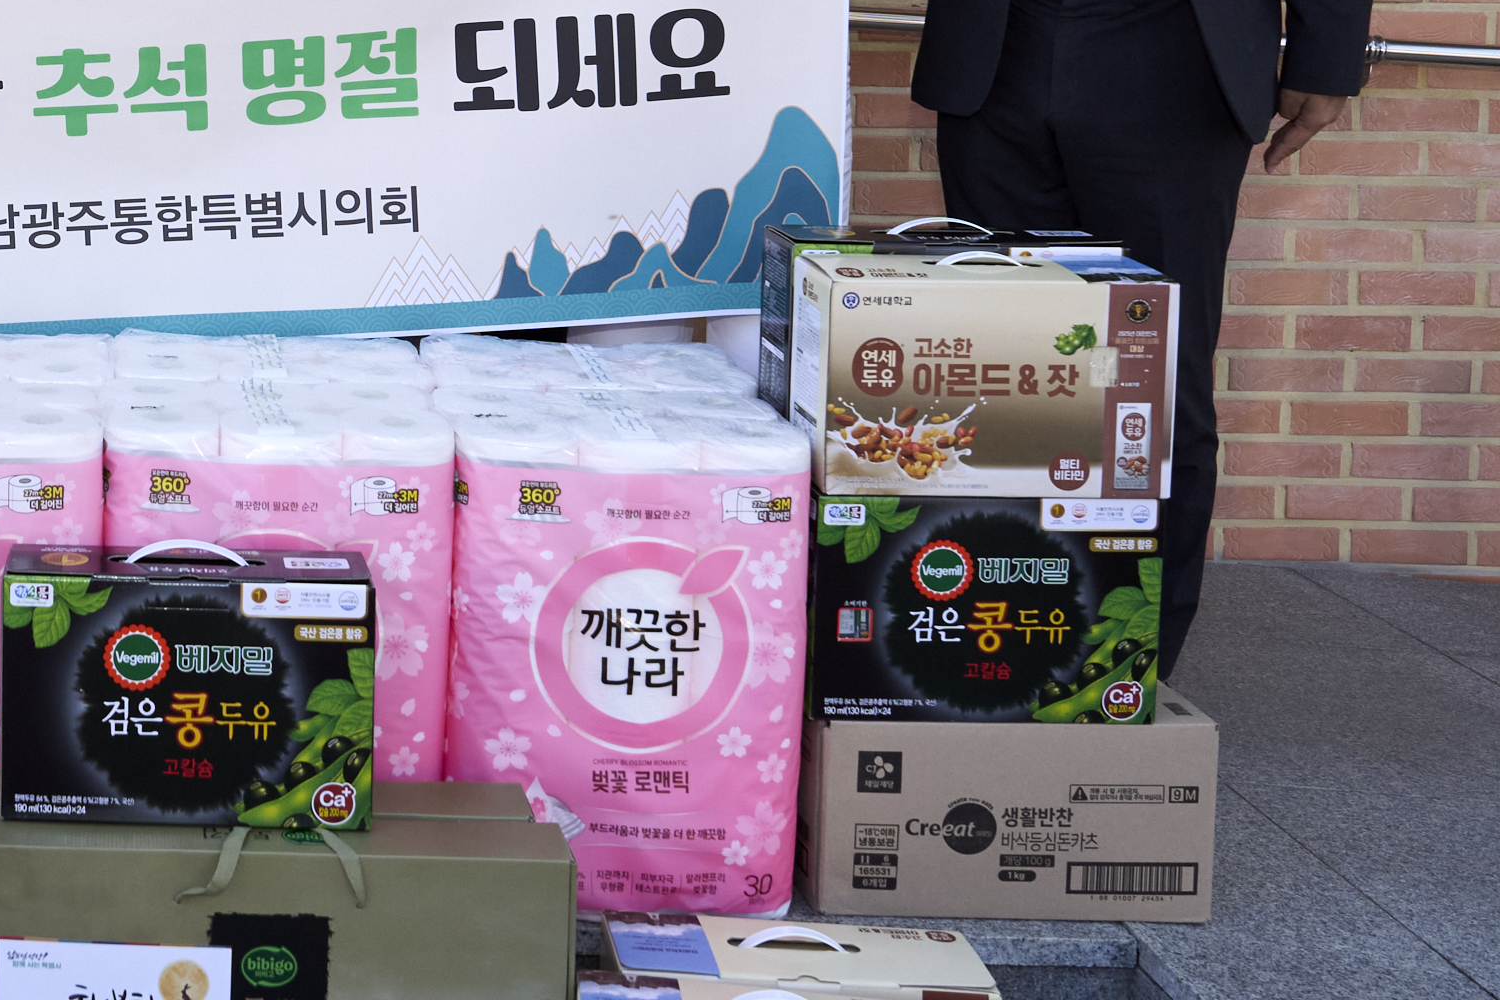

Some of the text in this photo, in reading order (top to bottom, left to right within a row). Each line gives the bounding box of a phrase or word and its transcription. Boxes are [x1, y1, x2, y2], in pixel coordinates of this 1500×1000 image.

[33, 43, 209, 137] 추석
[242, 27, 420, 128] 명절
[453, 8, 731, 114] 되세요
[863, 296, 912, 306] 연세대학교
[914, 338, 973, 359] 고소한
[861, 350, 897, 368] 연세
[861, 368, 896, 387] 두유
[1125, 417, 1143, 427] 연세
[1125, 427, 1143, 437] 두유
[1060, 459, 1080, 469] 멀티
[1054, 470, 1085, 481] 비타민
[30, 499, 64, 510] 더 길어진
[167, 494, 190, 504] 소프트
[235, 500, 319, 512] 깨끗함이 필요한 순간
[384, 502, 418, 513] 더 길어진
[536, 505, 561, 515] 소프트
[606, 508, 690, 520] 깨끗함이 필요한 순간
[758, 510, 791, 522] 더 길어진
[1094, 538, 1153, 550] 국산 검은콩 함유
[921, 564, 963, 577] Vegemil
[978, 557, 1070, 585] 베지밀
[299, 627, 363, 639] 국산 검은콩 함유
[580, 608, 706, 652] 깨끗한
[115, 650, 160, 665] Vegemil
[174, 644, 274, 676] 베지밀
[601, 657, 685, 696] 나라
[963, 662, 1012, 680] 고칼슘
[824, 706, 836, 715] 190
[163, 758, 214, 778] 고칼슘
[593, 758, 688, 767] CHERRY BLOSSOM ROMANTIC
[865, 764, 877, 774] CJ
[592, 770, 689, 794] 벚꽃 로맨틱
[864, 780, 894, 789] 제일제당
[14, 804, 27, 812] 190
[1001, 807, 1074, 828] 생활반찬
[589, 822, 726, 841] 부드러움과 벚꽃을 더 한 깨끗함
[905, 818, 976, 837] Creeat
[858, 837, 896, 848] 냉동보관
[1001, 831, 1099, 852] 바삭등심돈카츠
[1026, 856, 1043, 865] 100
[743, 873, 773, 898] 30
[247, 957, 294, 975] bibigo
